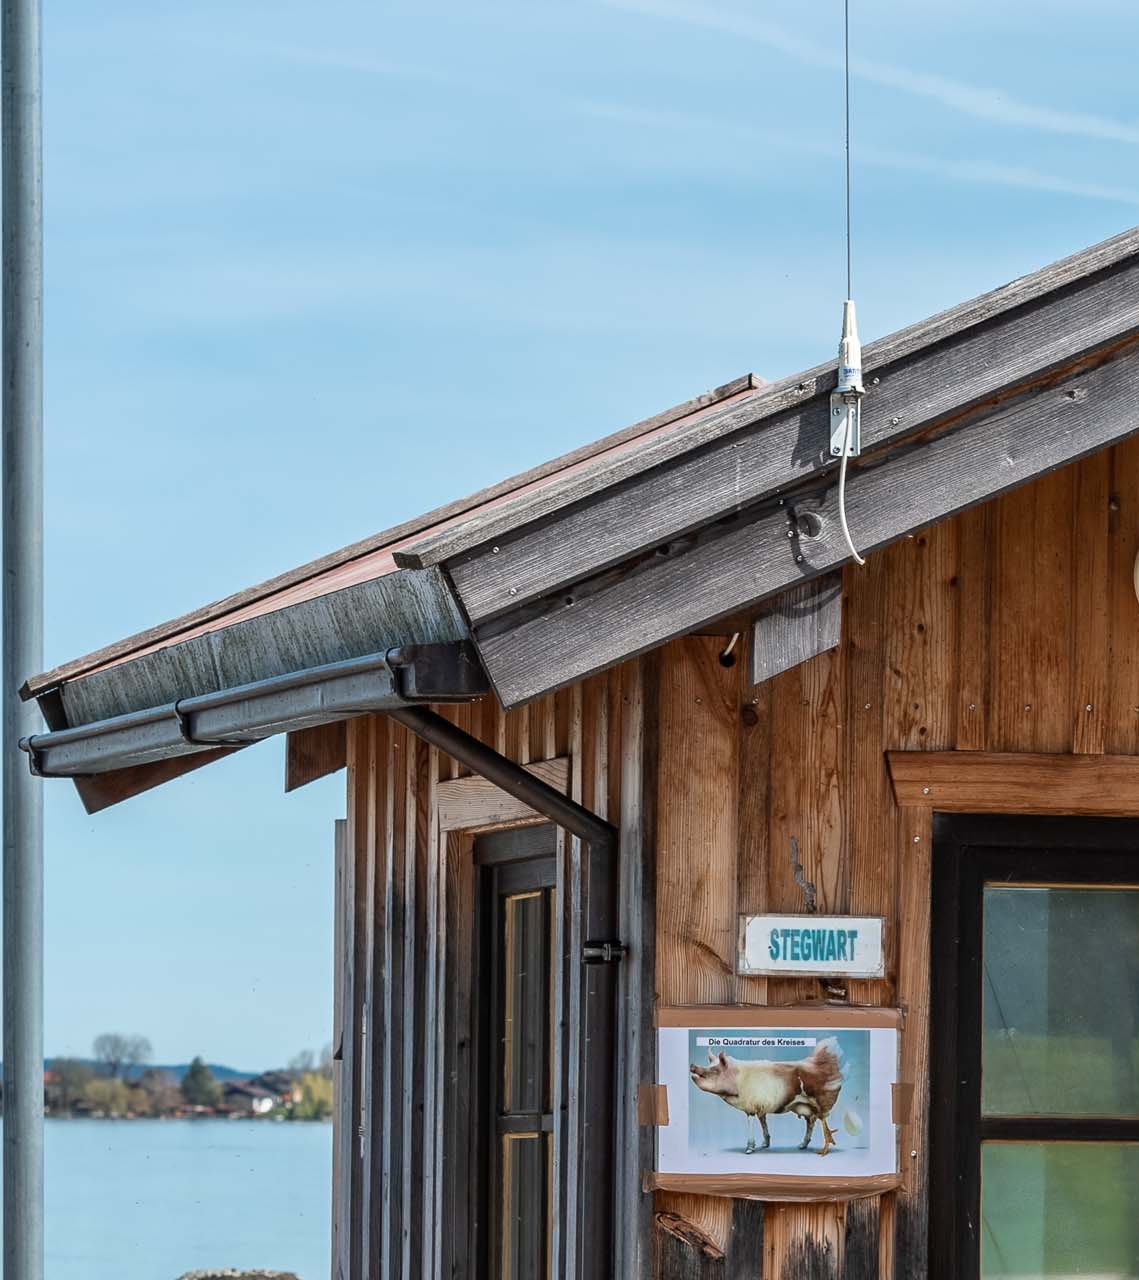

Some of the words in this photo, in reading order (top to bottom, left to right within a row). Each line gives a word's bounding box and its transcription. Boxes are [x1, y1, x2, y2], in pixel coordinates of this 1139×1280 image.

[769, 928, 858, 962] STEGWART
[708, 1038, 721, 1046] Die
[723, 1038, 760, 1046] Quadratur
[762, 1038, 776, 1046] des
